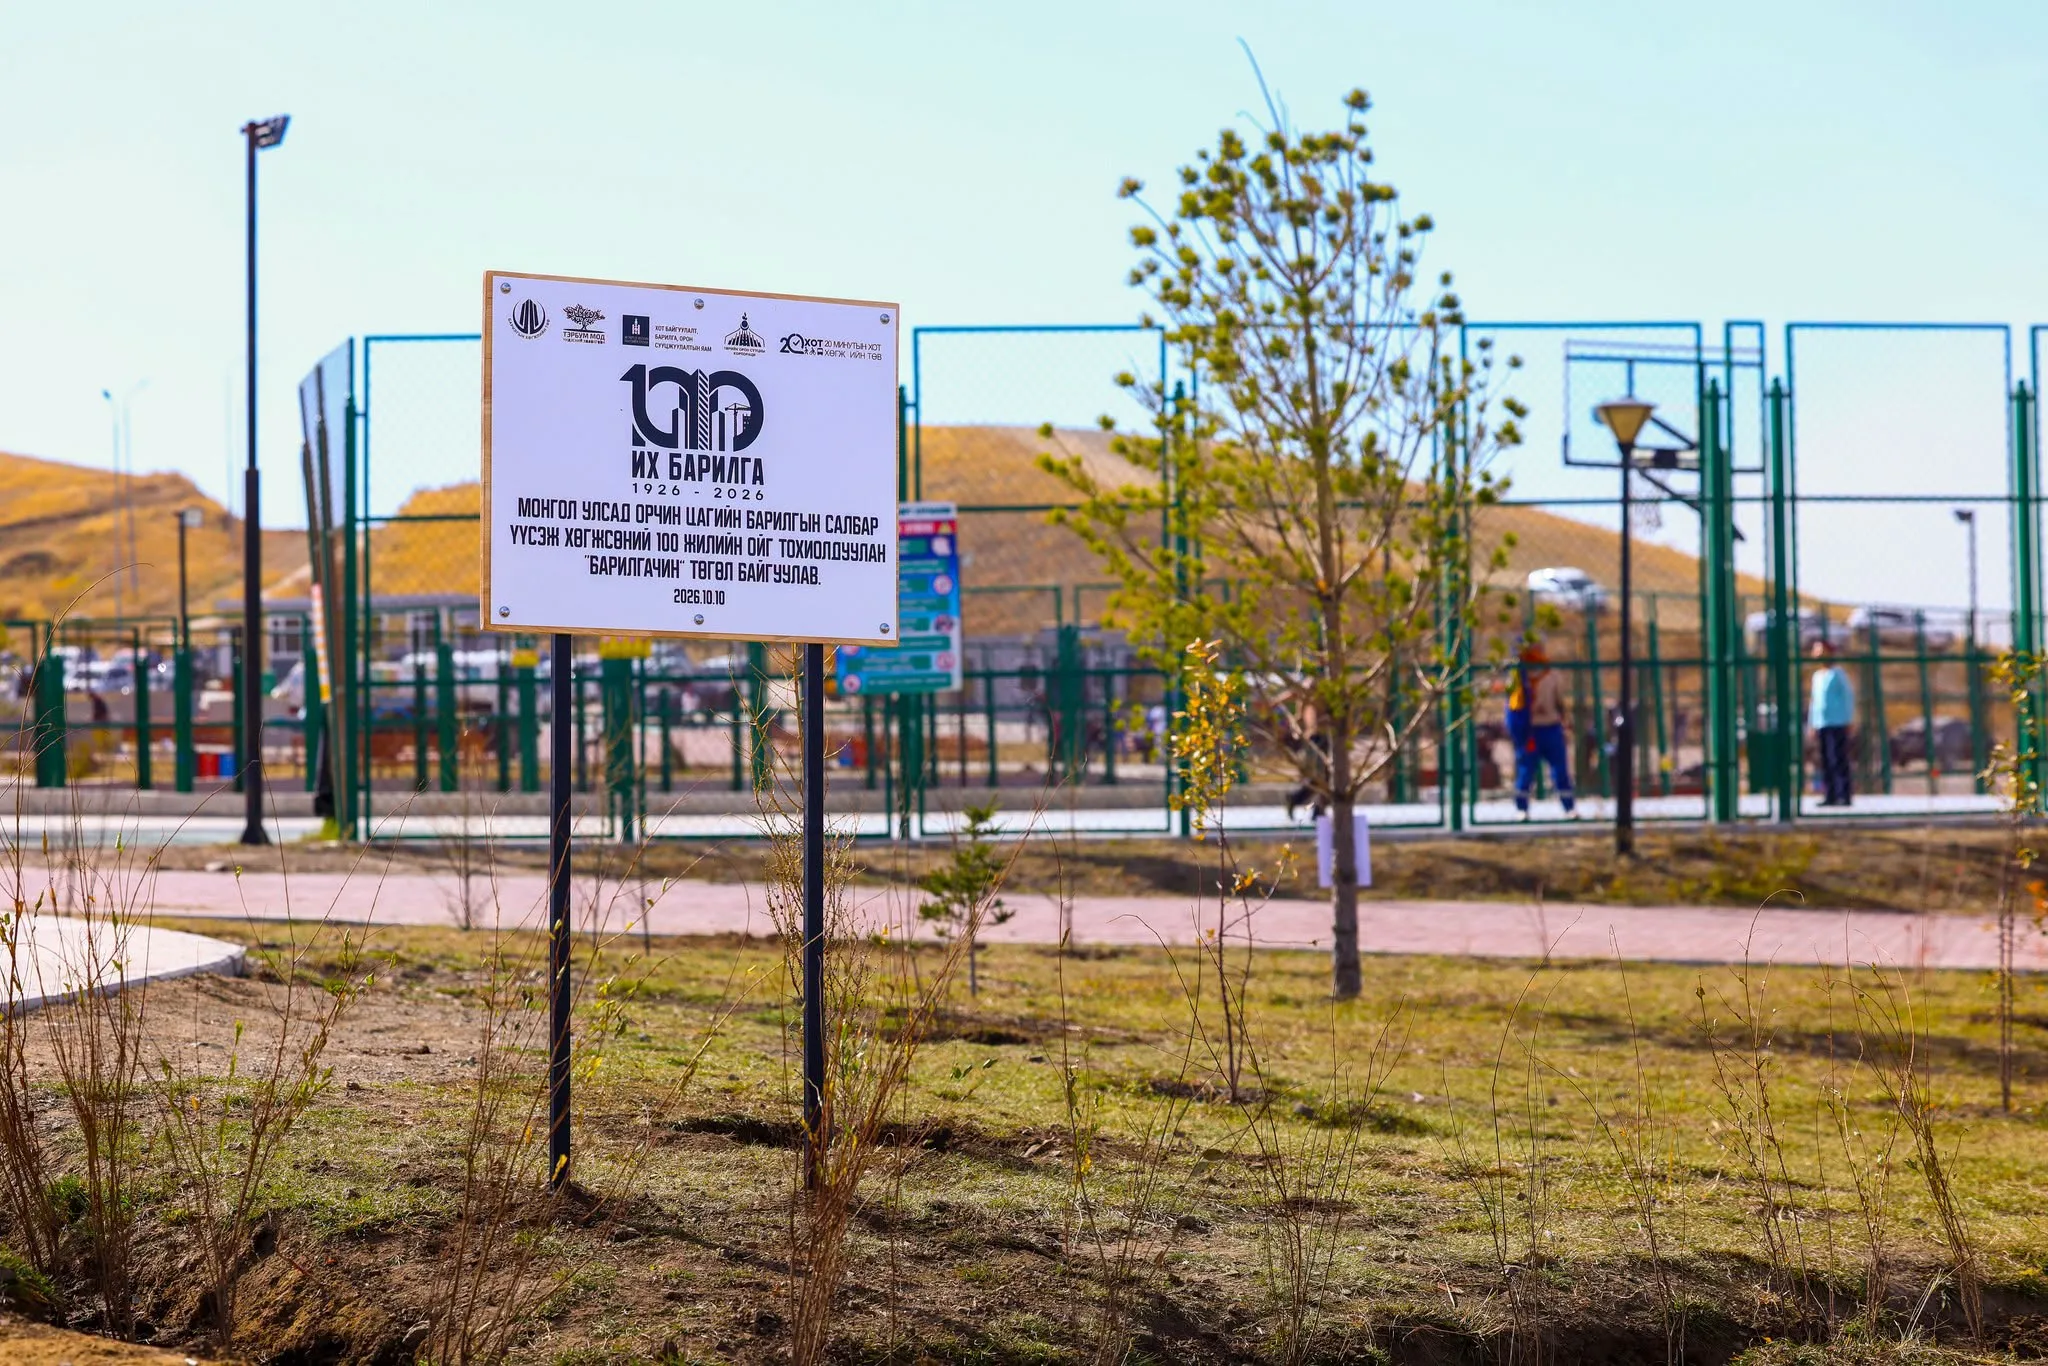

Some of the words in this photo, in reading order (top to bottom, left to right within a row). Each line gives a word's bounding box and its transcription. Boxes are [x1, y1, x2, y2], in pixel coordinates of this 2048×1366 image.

[563, 331, 588, 339] ТЭРБУМ
[590, 333, 605, 341] МОД
[655, 334, 678, 342] БАРИЛГА,
[804, 338, 823, 347] ХОТ
[824, 340, 832, 348] 20
[834, 341, 867, 350] МИНУТЫН
[868, 343, 881, 352] ХОТ
[867, 353, 882, 361] ТӨВ
[632, 450, 659, 479] ИХ
[669, 452, 764, 485] БАРИЛГА
[632, 483, 680, 496] 1926
[714, 488, 764, 500] 2026
[518, 498, 577, 520] МОНГОЛ
[582, 501, 630, 523] УЛСАД
[635, 504, 681, 526] ОРЧИН
[686, 505, 741, 529] ЦАГИЙН
[746, 510, 820, 533] БАРИЛГЫН
[825, 515, 878, 536] САЛБАР
[510, 525, 559, 546] ҮҮСЭЖ
[565, 528, 650, 551] ХӨГЖСӨНИЙ
[656, 532, 678, 552] 100
[684, 532, 742, 555] ЖИЛИЙН
[748, 534, 773, 557] ОЙГ
[779, 539, 886, 563] ТОХИОЛДУУЛАН
[690, 560, 733, 581] ТӨГӨЛ
[738, 560, 821, 585] БАЙГУУЛАВ.
[674, 589, 725, 605] 2026.10.10
